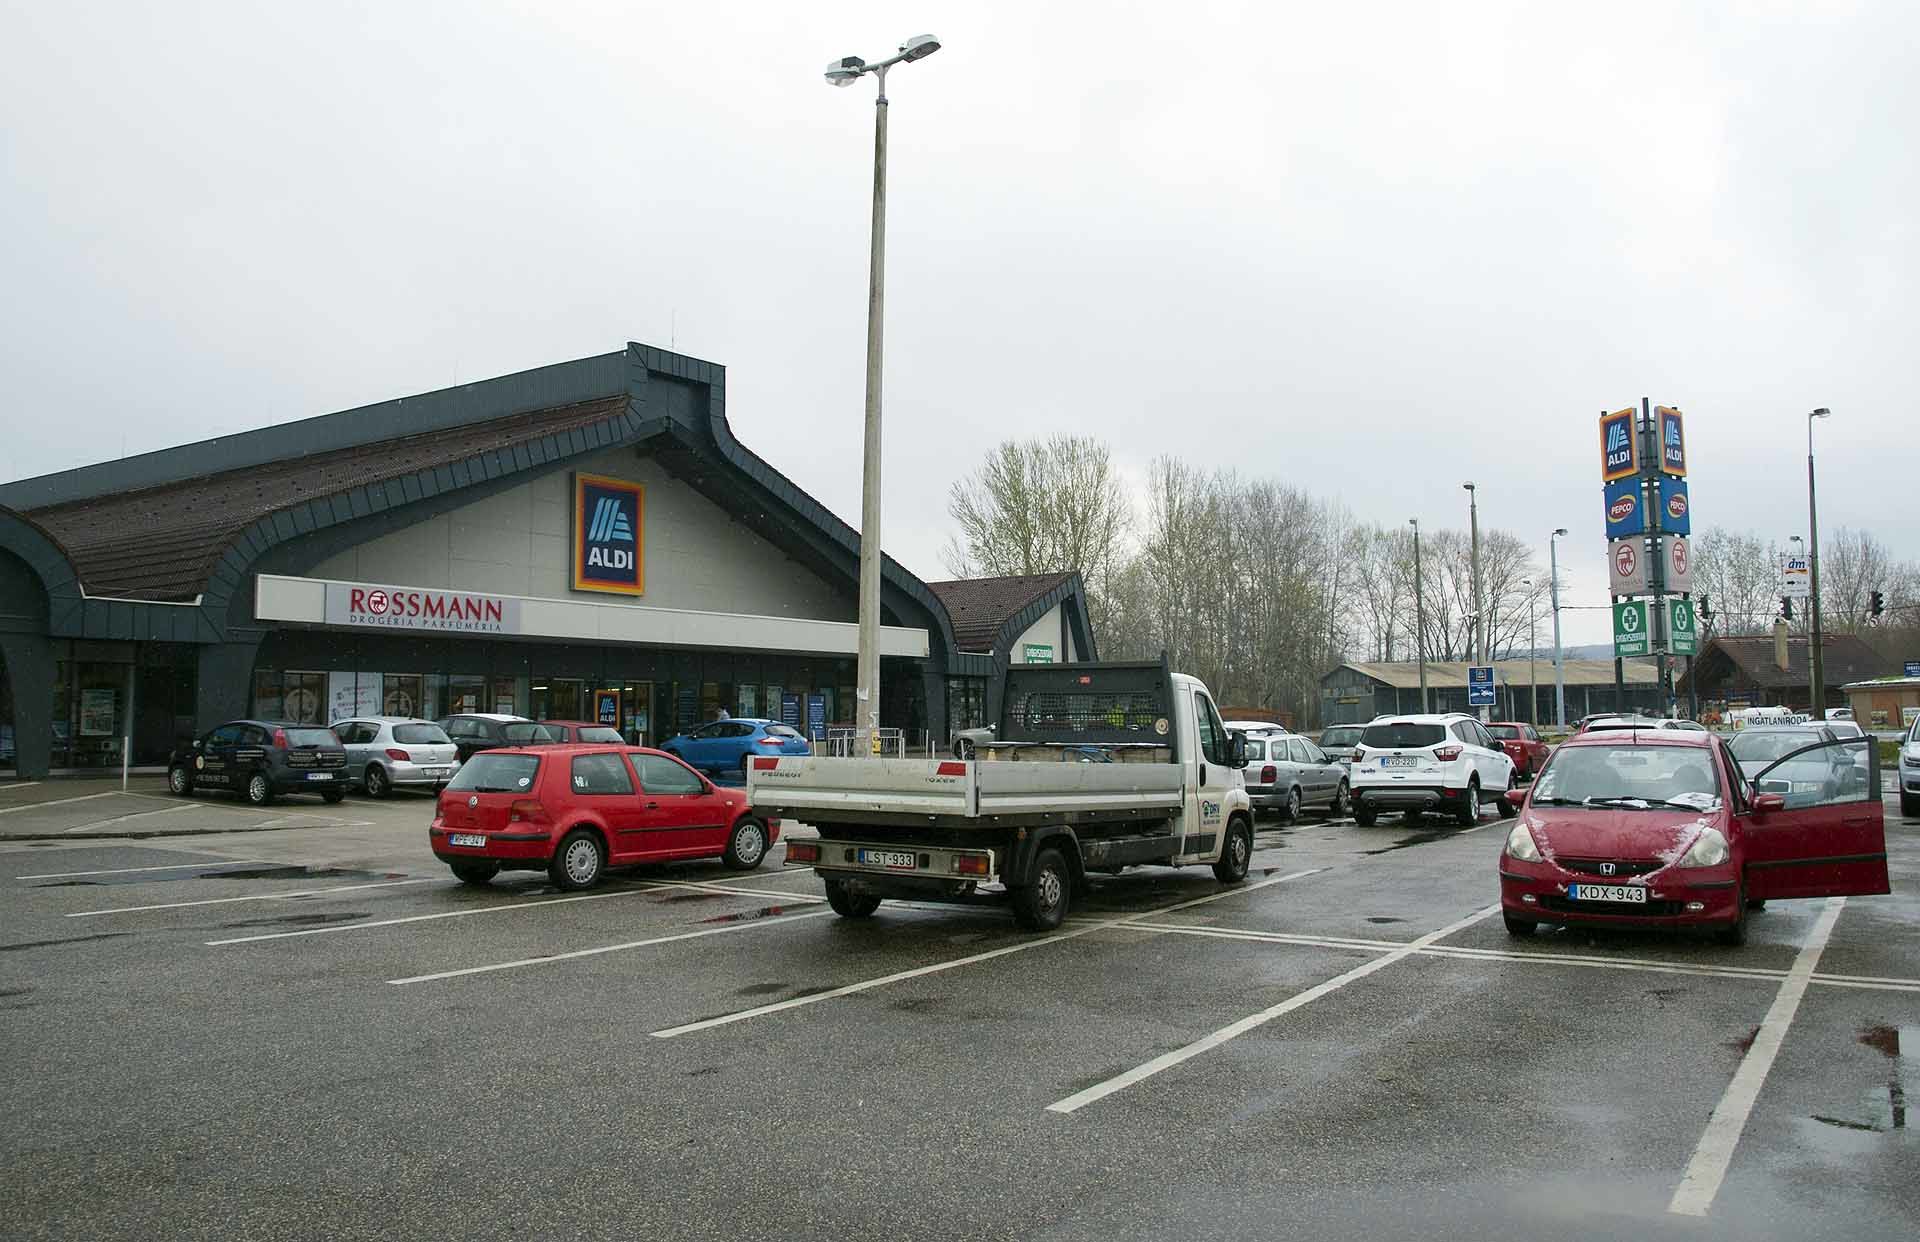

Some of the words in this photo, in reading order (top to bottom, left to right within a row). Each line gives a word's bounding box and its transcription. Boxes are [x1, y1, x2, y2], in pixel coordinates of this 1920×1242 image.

[1608, 450, 1630, 467] ALDI
[1666, 448, 1682, 463] ALDI
[1610, 502, 1633, 515] PEPCO
[1669, 500, 1686, 512] PEPCO
[588, 547, 633, 569] ALDI
[1788, 558, 1806, 569] dm
[350, 589, 502, 622] ROSSMANN
[350, 615, 414, 627] DROGÉRIA
[423, 619, 502, 632] PARFÜMÉRIA
[1747, 716, 1807, 725] INGATLANIRODA
[866, 851, 912, 866] LST-933
[1580, 886, 1643, 901] KDX-943
